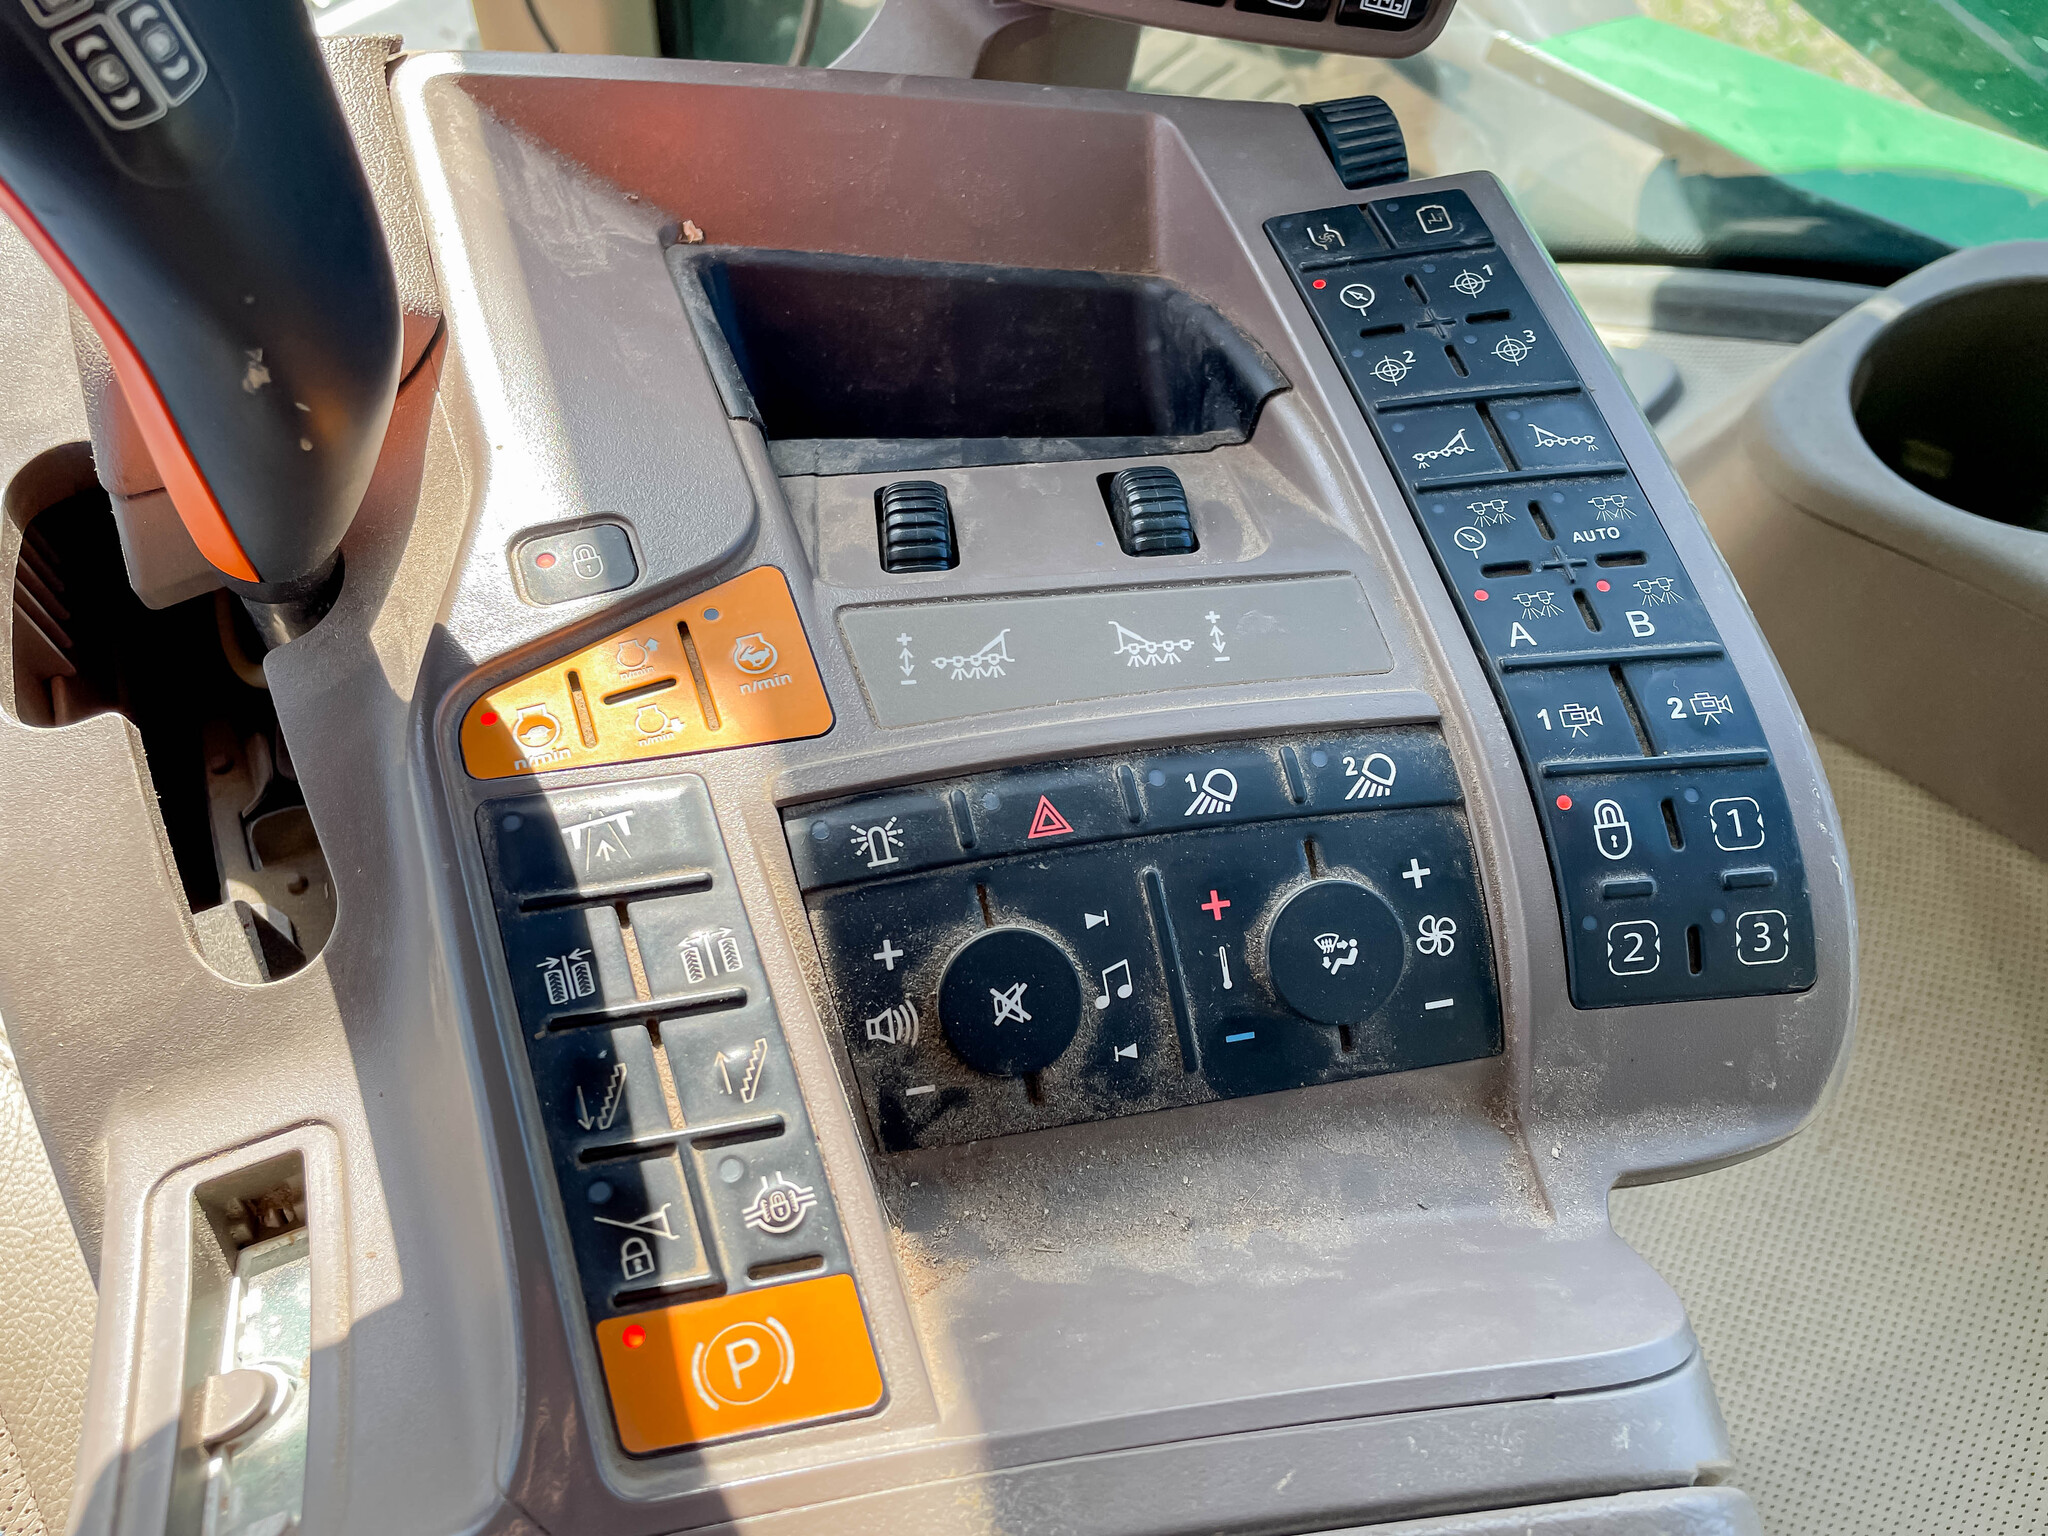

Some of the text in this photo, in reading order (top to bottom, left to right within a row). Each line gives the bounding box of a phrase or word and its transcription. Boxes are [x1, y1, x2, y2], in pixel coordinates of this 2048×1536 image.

[1482, 264, 1493, 277] 1
[1523, 329, 1536, 343] 3
[1403, 350, 1416, 363] 2
[1572, 527, 1621, 543] AUTO
[1510, 621, 1537, 648] A
[1625, 610, 1656, 638] B
[619, 665, 655, 681] n/min
[739, 671, 792, 695] n/min
[1537, 708, 1552, 730] 1
[1667, 697, 1687, 719] 2
[637, 730, 675, 747] n/min
[513, 746, 571, 770] n/min
[1342, 756, 1358, 776] 2
[1184, 773, 1197, 792] 1
[1727, 808, 1742, 838] 1
[1623, 932, 1645, 962] 2
[1753, 922, 1772, 952] 3
[725, 1337, 761, 1389] P
